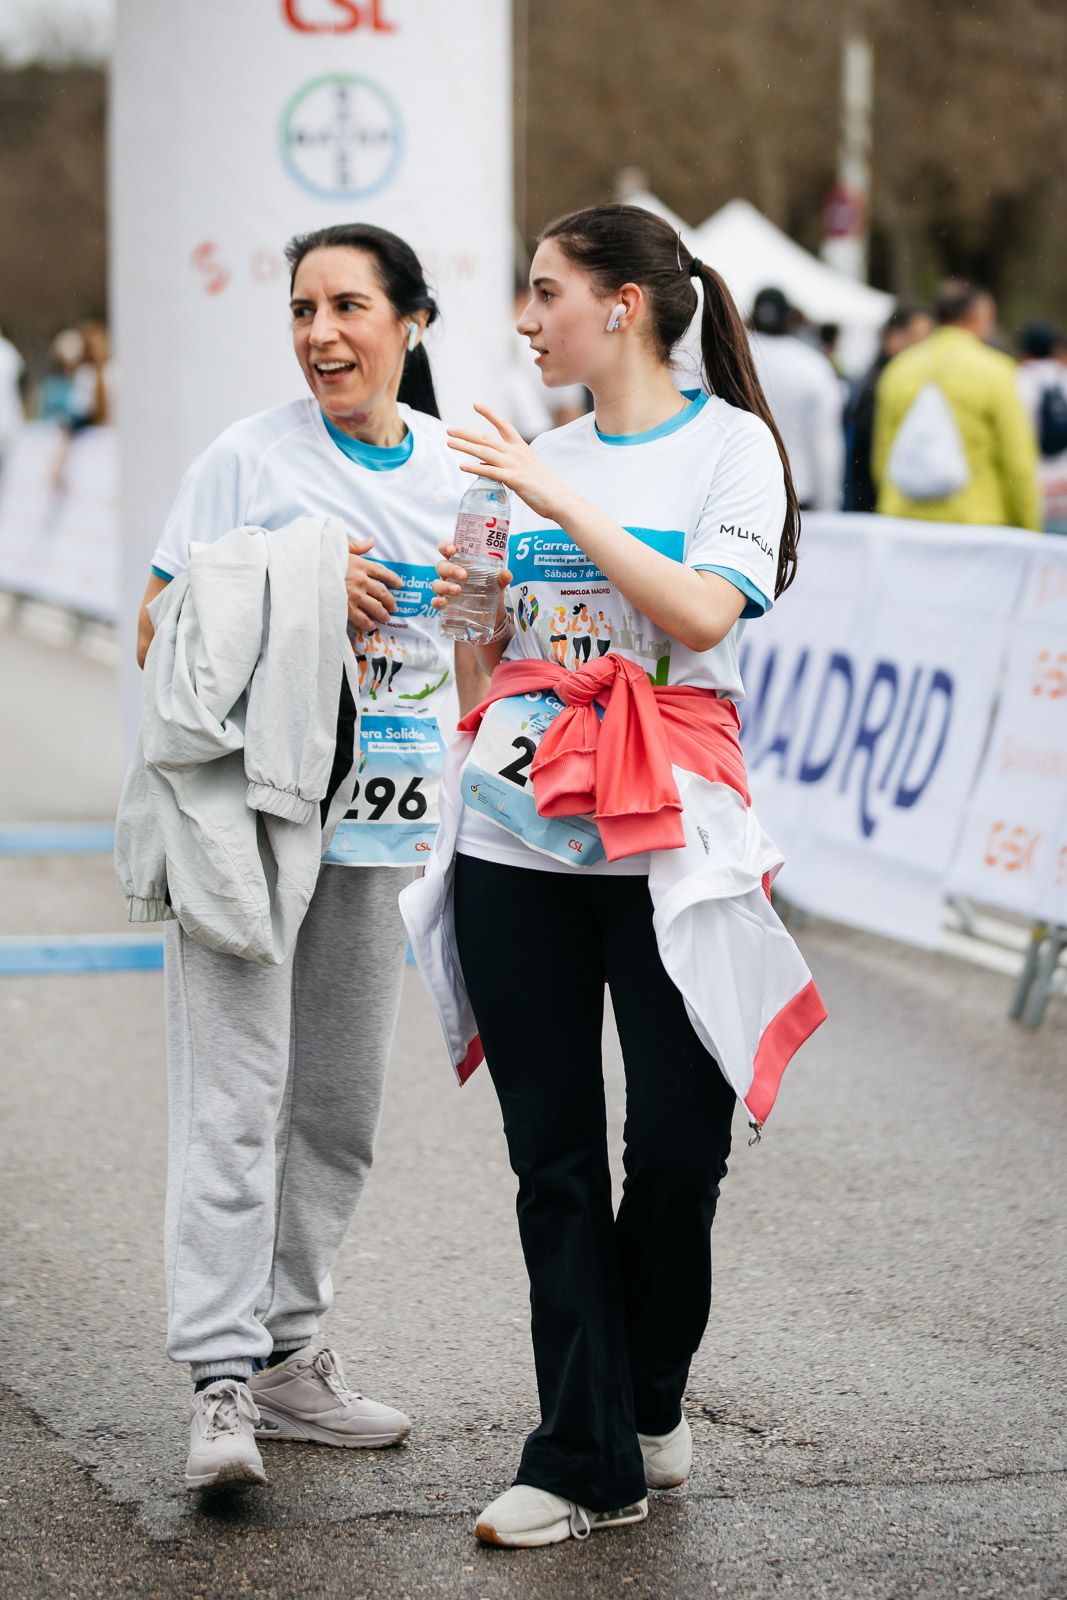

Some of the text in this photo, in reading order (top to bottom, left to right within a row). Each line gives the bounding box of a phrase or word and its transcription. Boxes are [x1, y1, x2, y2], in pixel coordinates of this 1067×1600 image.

[486, 538, 507, 549] SOD
[720, 524, 774, 560] MUKUA
[544, 569, 577, 579] Sábado
[579, 569, 585, 578] 7
[585, 569, 594, 578] de
[591, 587, 610, 595] MADRID
[414, 842, 432, 852] CSL
[568, 839, 583, 853] CSL
